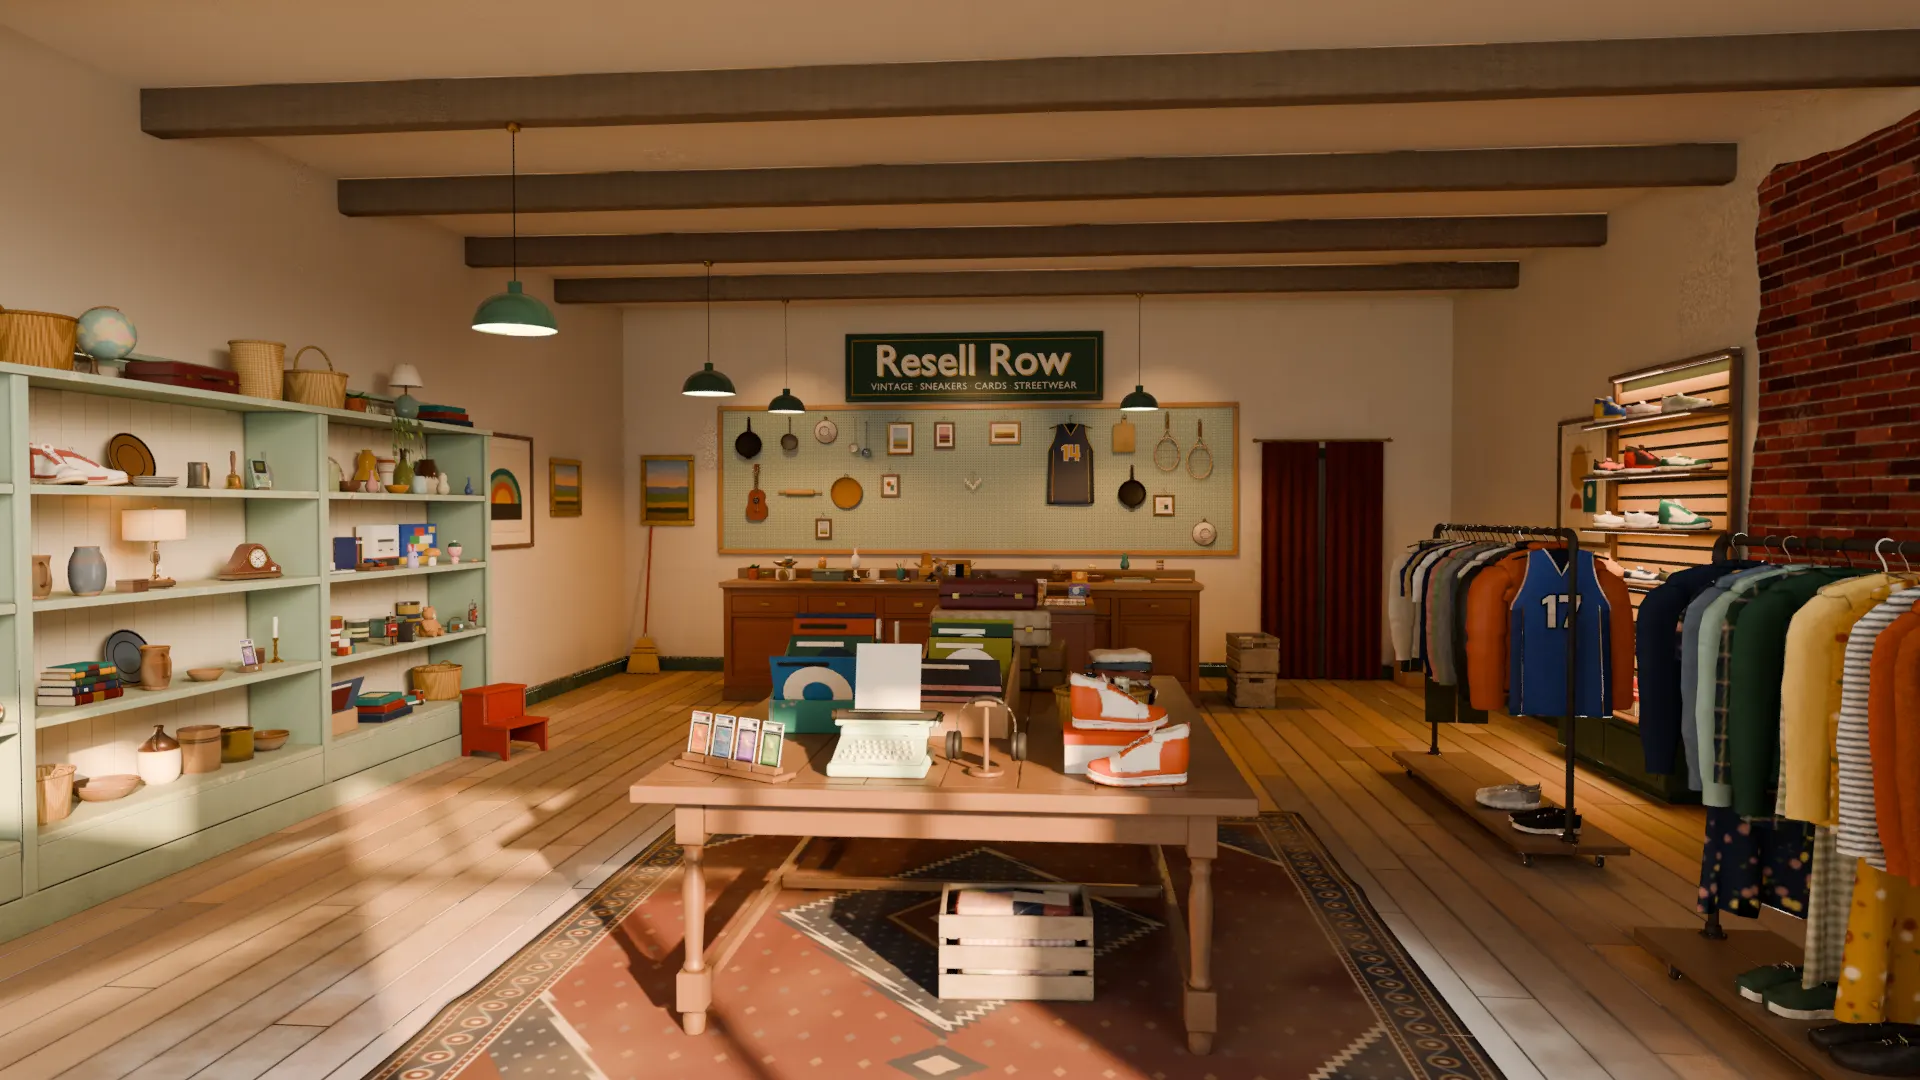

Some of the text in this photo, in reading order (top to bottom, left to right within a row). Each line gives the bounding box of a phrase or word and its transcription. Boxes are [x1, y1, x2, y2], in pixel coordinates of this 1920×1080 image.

[876, 343, 1072, 378] Resell Row
[870, 380, 1077, 391] VINTAGE SNEAKERS CARDS STREETWEAR
[1060, 443, 1081, 462] 14
